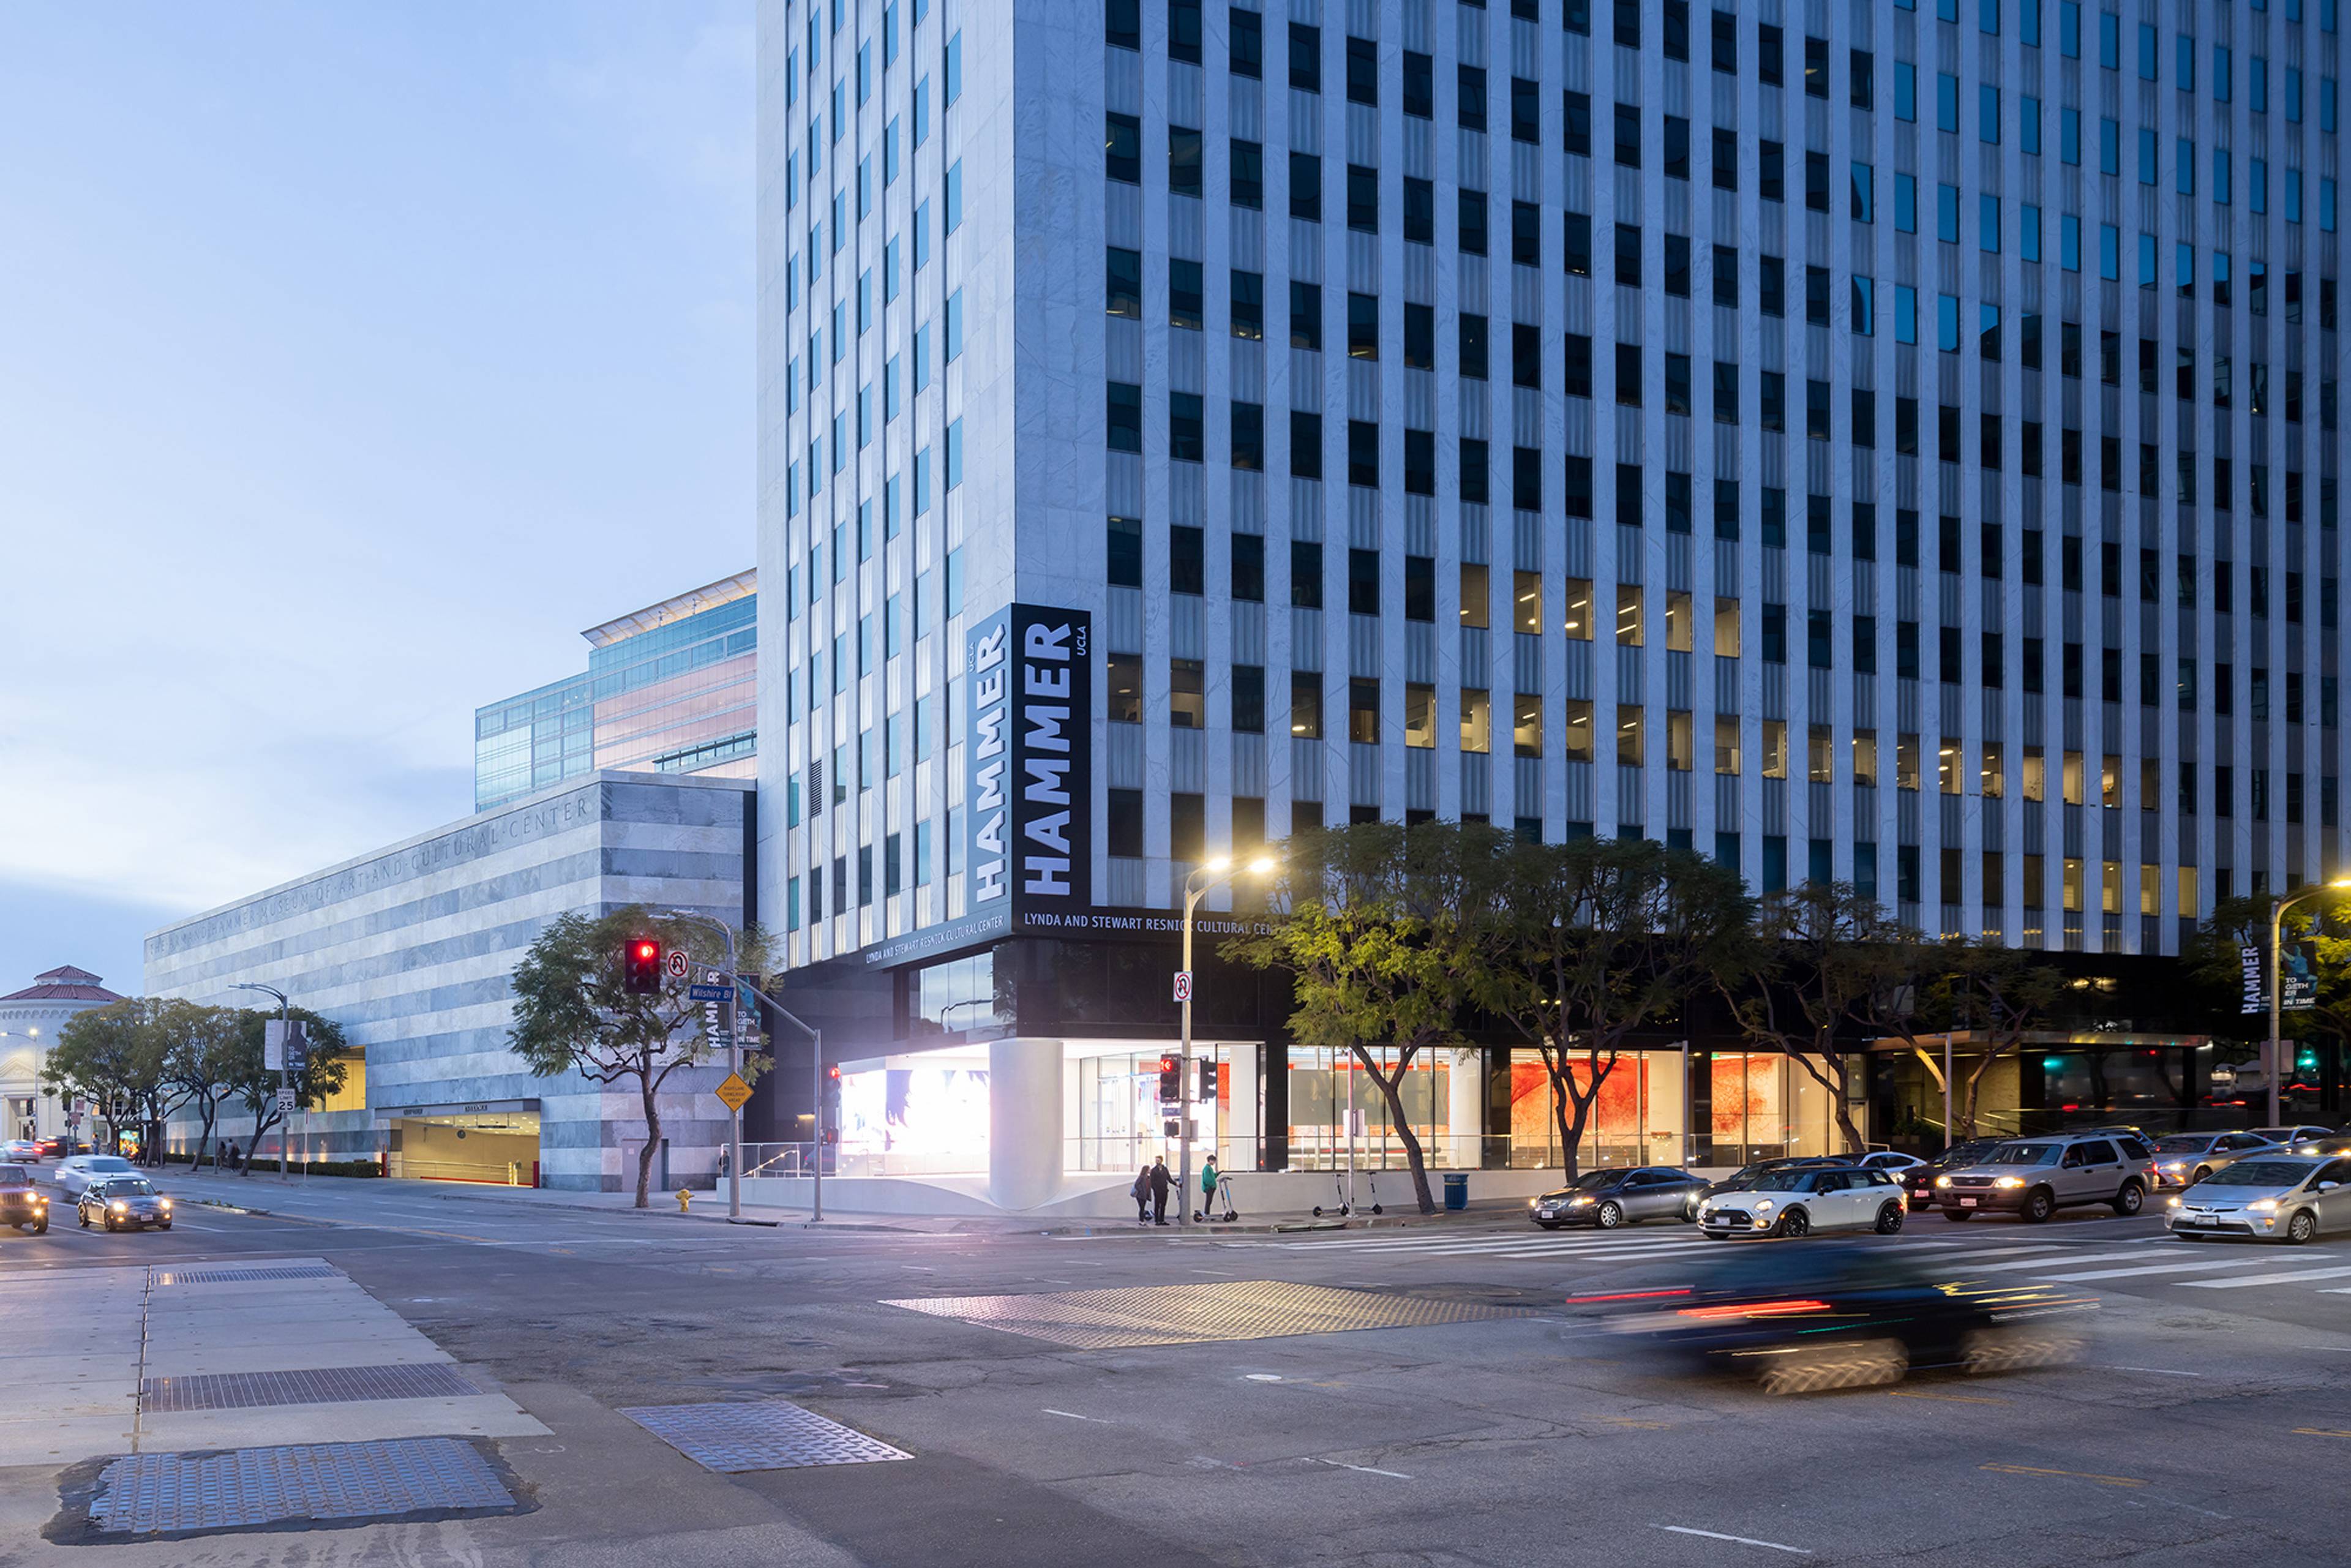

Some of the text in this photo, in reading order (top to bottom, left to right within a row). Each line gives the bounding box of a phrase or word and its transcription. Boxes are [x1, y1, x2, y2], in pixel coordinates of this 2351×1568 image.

[1077, 625, 1087, 657] UCLA
[977, 623, 1005, 902] HAMMER
[1025, 623, 1071, 896] HAMMER
[211, 910, 255, 935] HAMMER
[260, 892, 310, 920] MUSEUM
[316, 883, 331, 901] OF
[339, 872, 366, 895] ART
[372, 861, 402, 883] AND
[411, 828, 499, 869] CULTURAL
[509, 798, 587, 838] CENTER
[947, 923, 977, 942] CULTURAL
[978, 915, 1005, 933] CENTER
[1024, 913, 1061, 926] LYNDA
[1064, 915, 1089, 928] AND
[1092, 915, 1142, 930] STEWART
[1196, 920, 1251, 934] CULTURAL
[692, 988, 732, 999] Wilshire Bl
[2241, 946, 2260, 1014] HAMMER
[279, 1101, 294, 1111] 25
